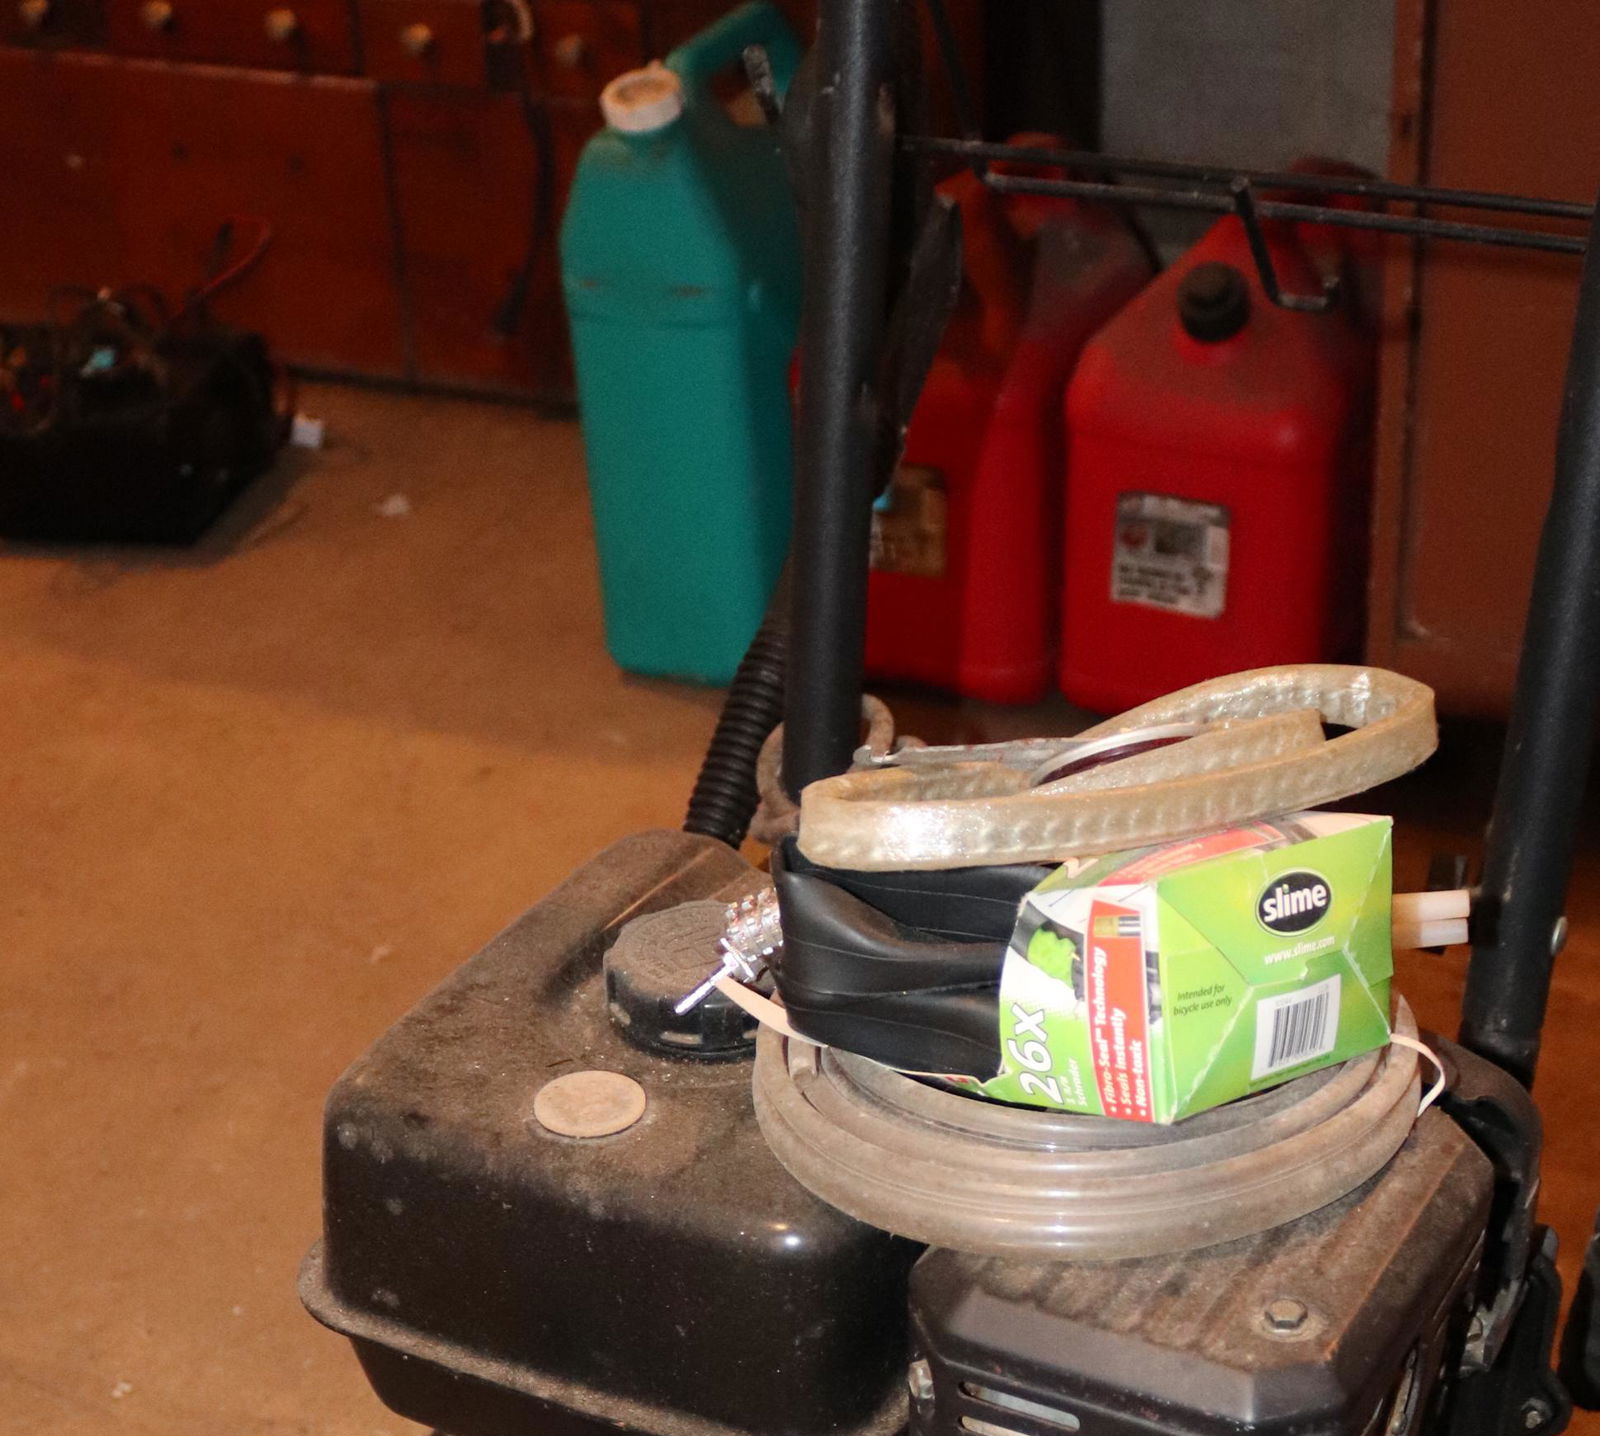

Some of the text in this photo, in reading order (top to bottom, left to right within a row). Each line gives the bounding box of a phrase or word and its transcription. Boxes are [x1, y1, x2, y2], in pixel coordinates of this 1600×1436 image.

[1263, 884, 1327, 922] slime
[1264, 936, 1335, 965] www.slime.com
[1092, 946, 1108, 1025] Technology
[1177, 983, 1226, 1001] Intended for
[1173, 995, 1233, 1016] bicycle use only
[1116, 1072, 1132, 1106] Seals
[1129, 1039, 1147, 1107] Non-toxic
